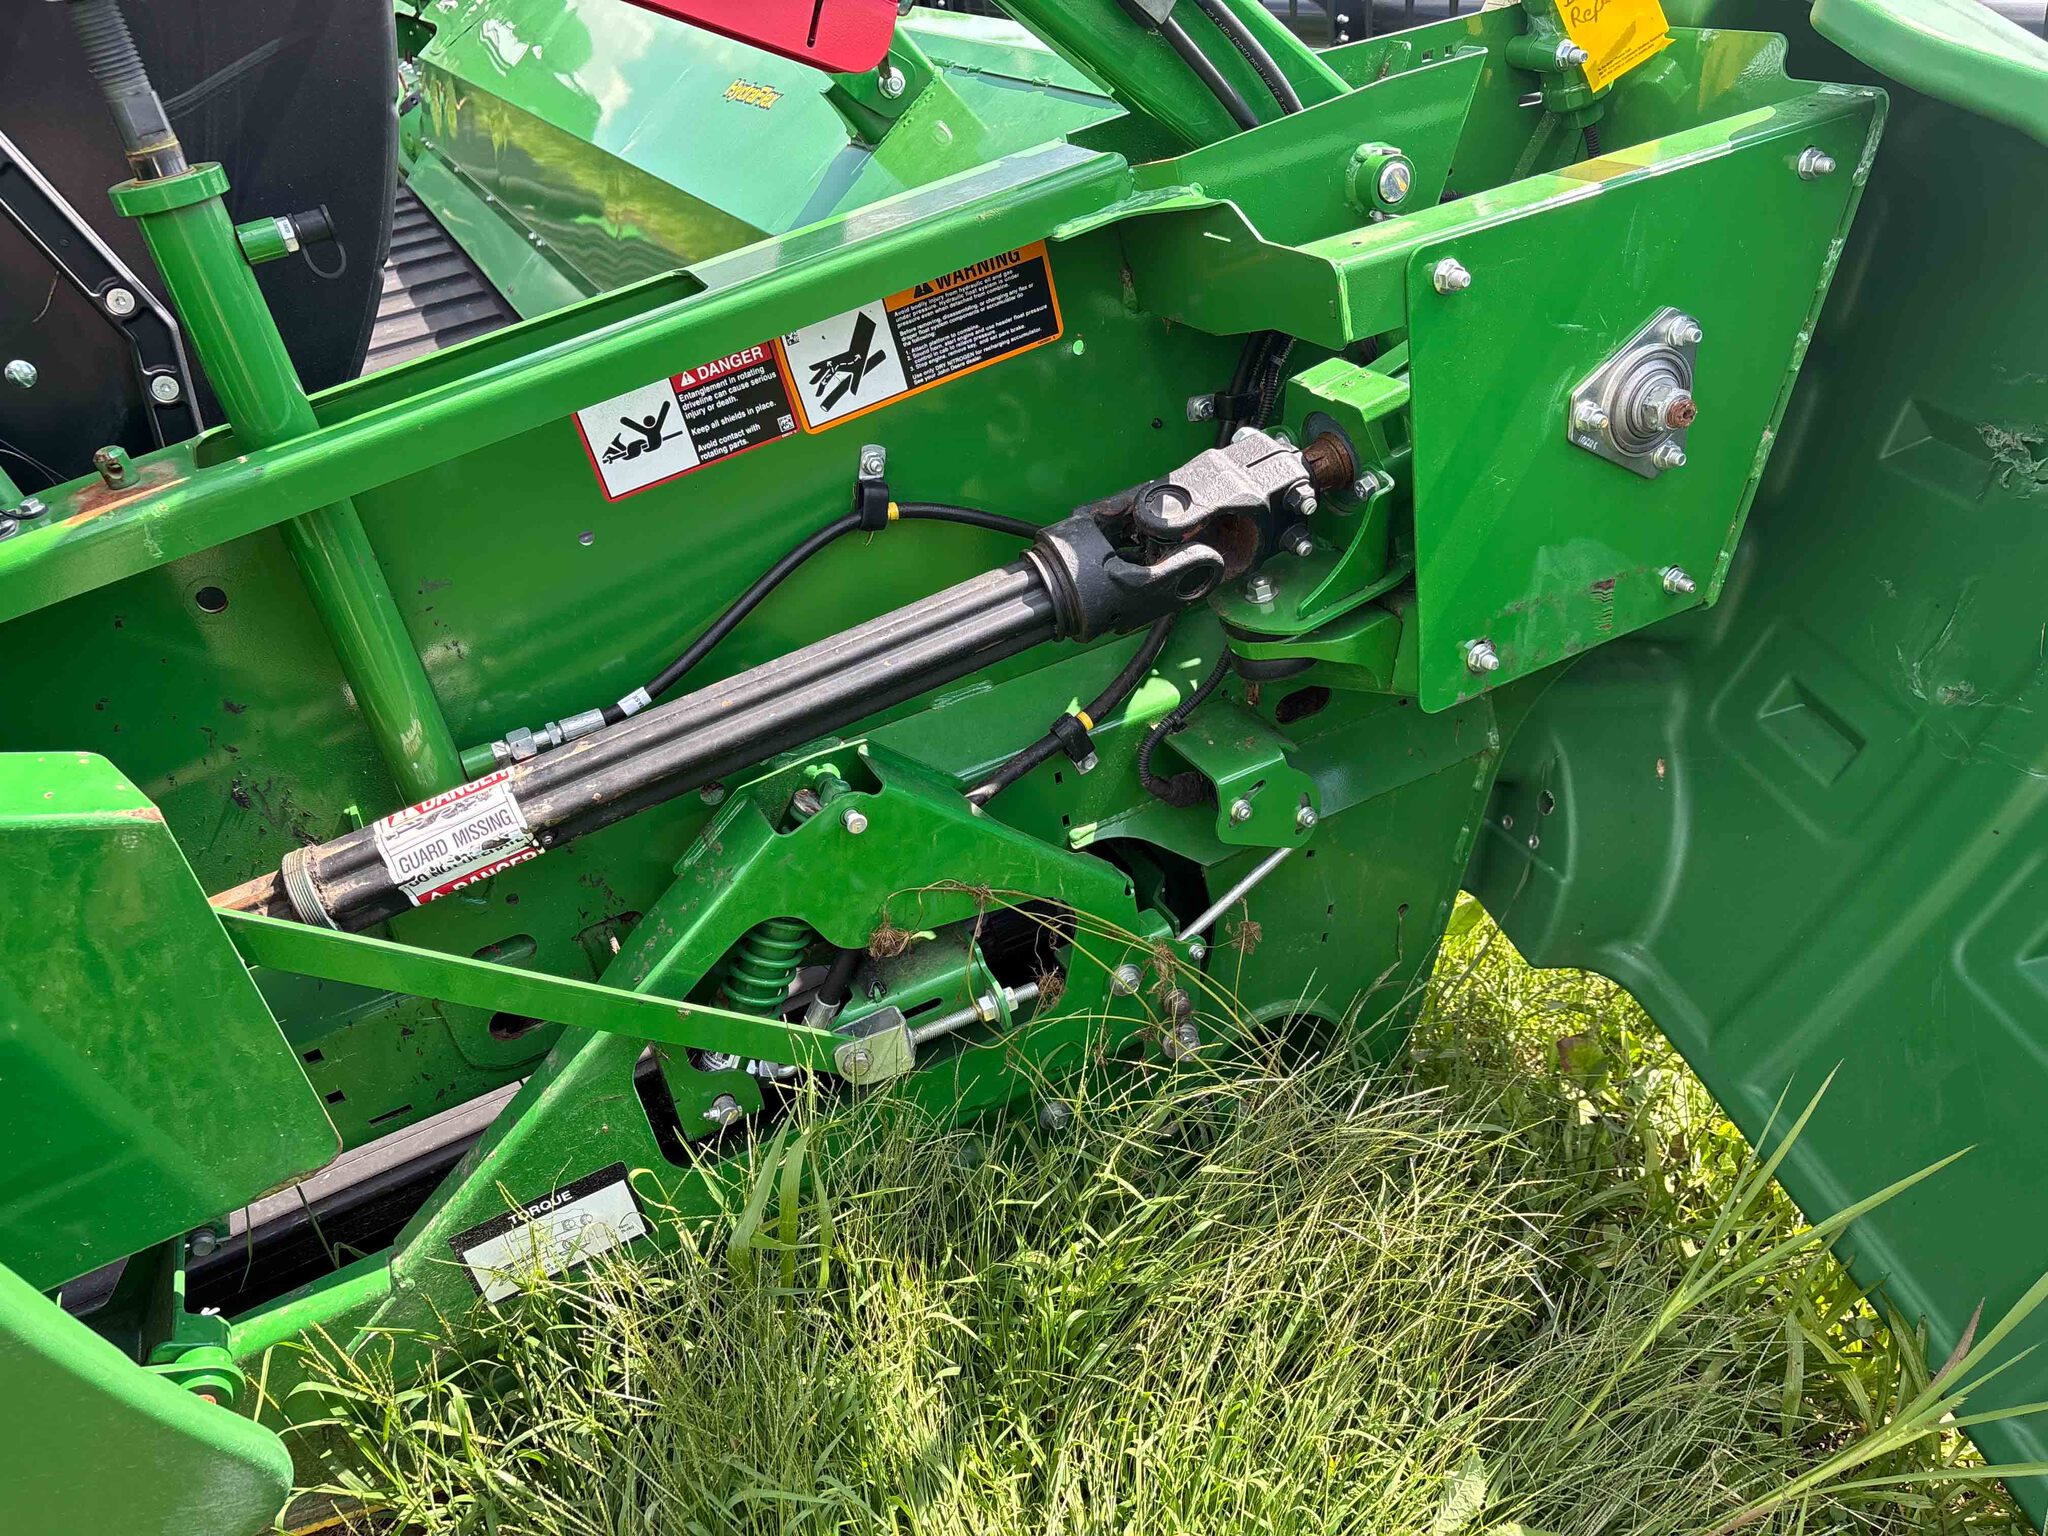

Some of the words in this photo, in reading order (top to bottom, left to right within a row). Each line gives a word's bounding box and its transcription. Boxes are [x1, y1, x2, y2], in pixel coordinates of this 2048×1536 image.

[894, 307, 909, 316] Avoid
[958, 280, 982, 292] hydraulic
[934, 305, 948, 313] when
[949, 295, 972, 308] detached
[899, 327, 916, 336] Before
[911, 343, 927, 353] Attach
[697, 346, 764, 380] DANGER
[678, 379, 727, 401] Entanglement
[737, 366, 764, 380] rotating
[682, 395, 712, 410] driveline
[713, 389, 727, 399] can
[728, 381, 749, 393] cause
[750, 371, 776, 385] serious
[684, 407, 705, 419] injury
[706, 403, 714, 411] or
[716, 395, 737, 407] death.
[690, 424, 709, 435] Keep
[710, 419, 719, 428] all
[720, 411, 745, 424] shields
[746, 407, 754, 415] in
[754, 400, 776, 413] place.
[697, 439, 717, 451] Avoid
[718, 429, 744, 444] contact
[745, 423, 760, 433] with
[700, 446, 728, 459] rotating
[728, 438, 748, 451] parts.
[399, 839, 448, 874] GUARD
[452, 809, 512, 847] MISSING
[507, 1190, 573, 1224] TORQUE
